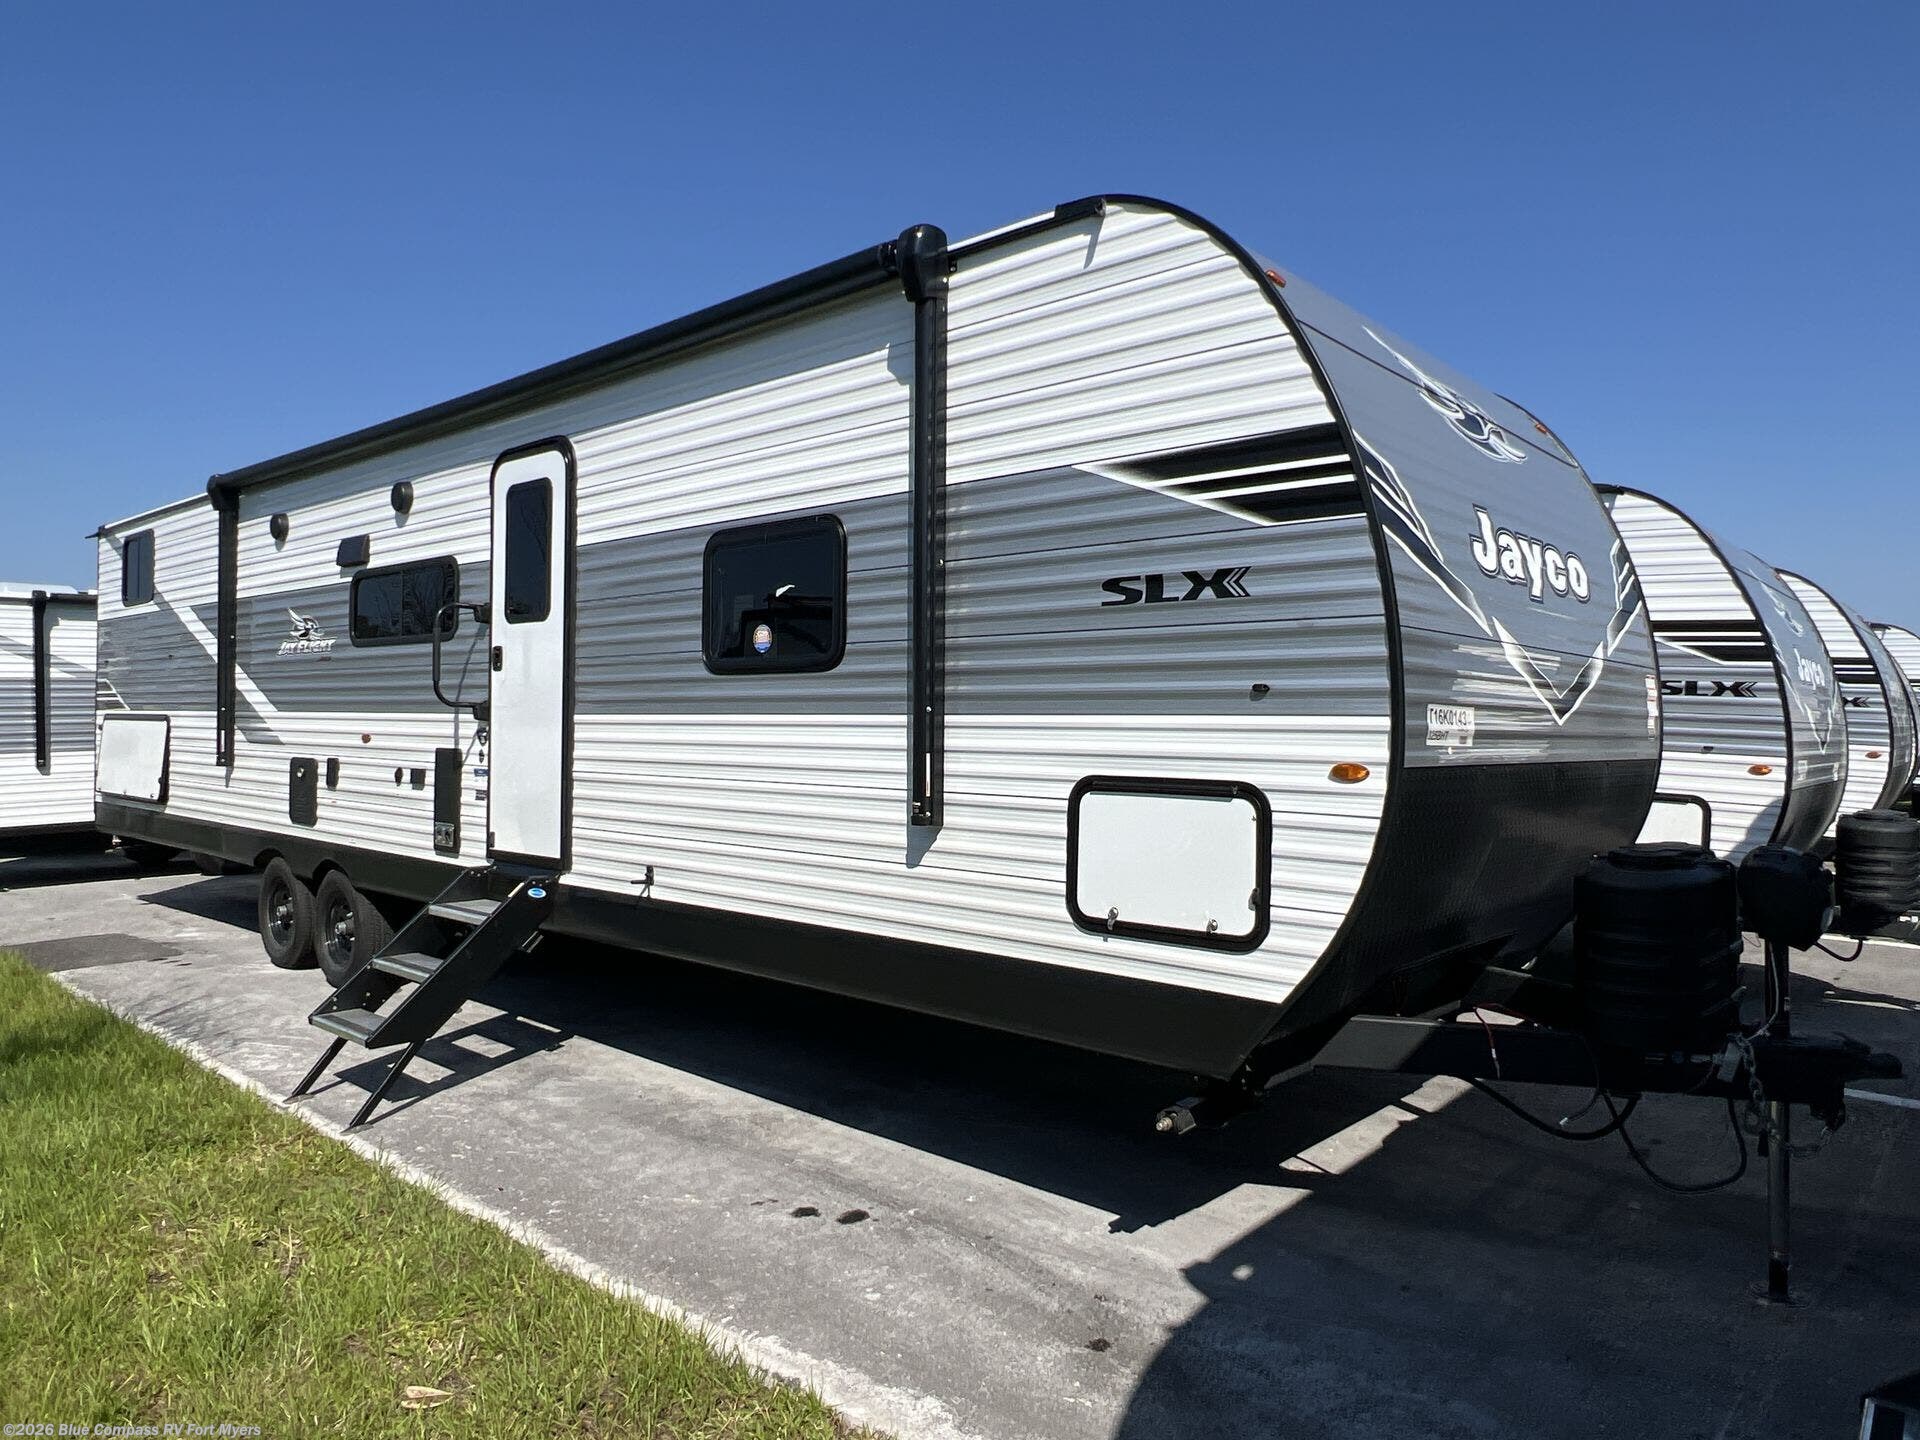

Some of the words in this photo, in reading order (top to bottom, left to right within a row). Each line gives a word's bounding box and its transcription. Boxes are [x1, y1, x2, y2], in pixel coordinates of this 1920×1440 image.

[1468, 503, 1591, 605] Jayco
[1101, 566, 1252, 606] SLX
[1660, 680, 1758, 697] SLX
